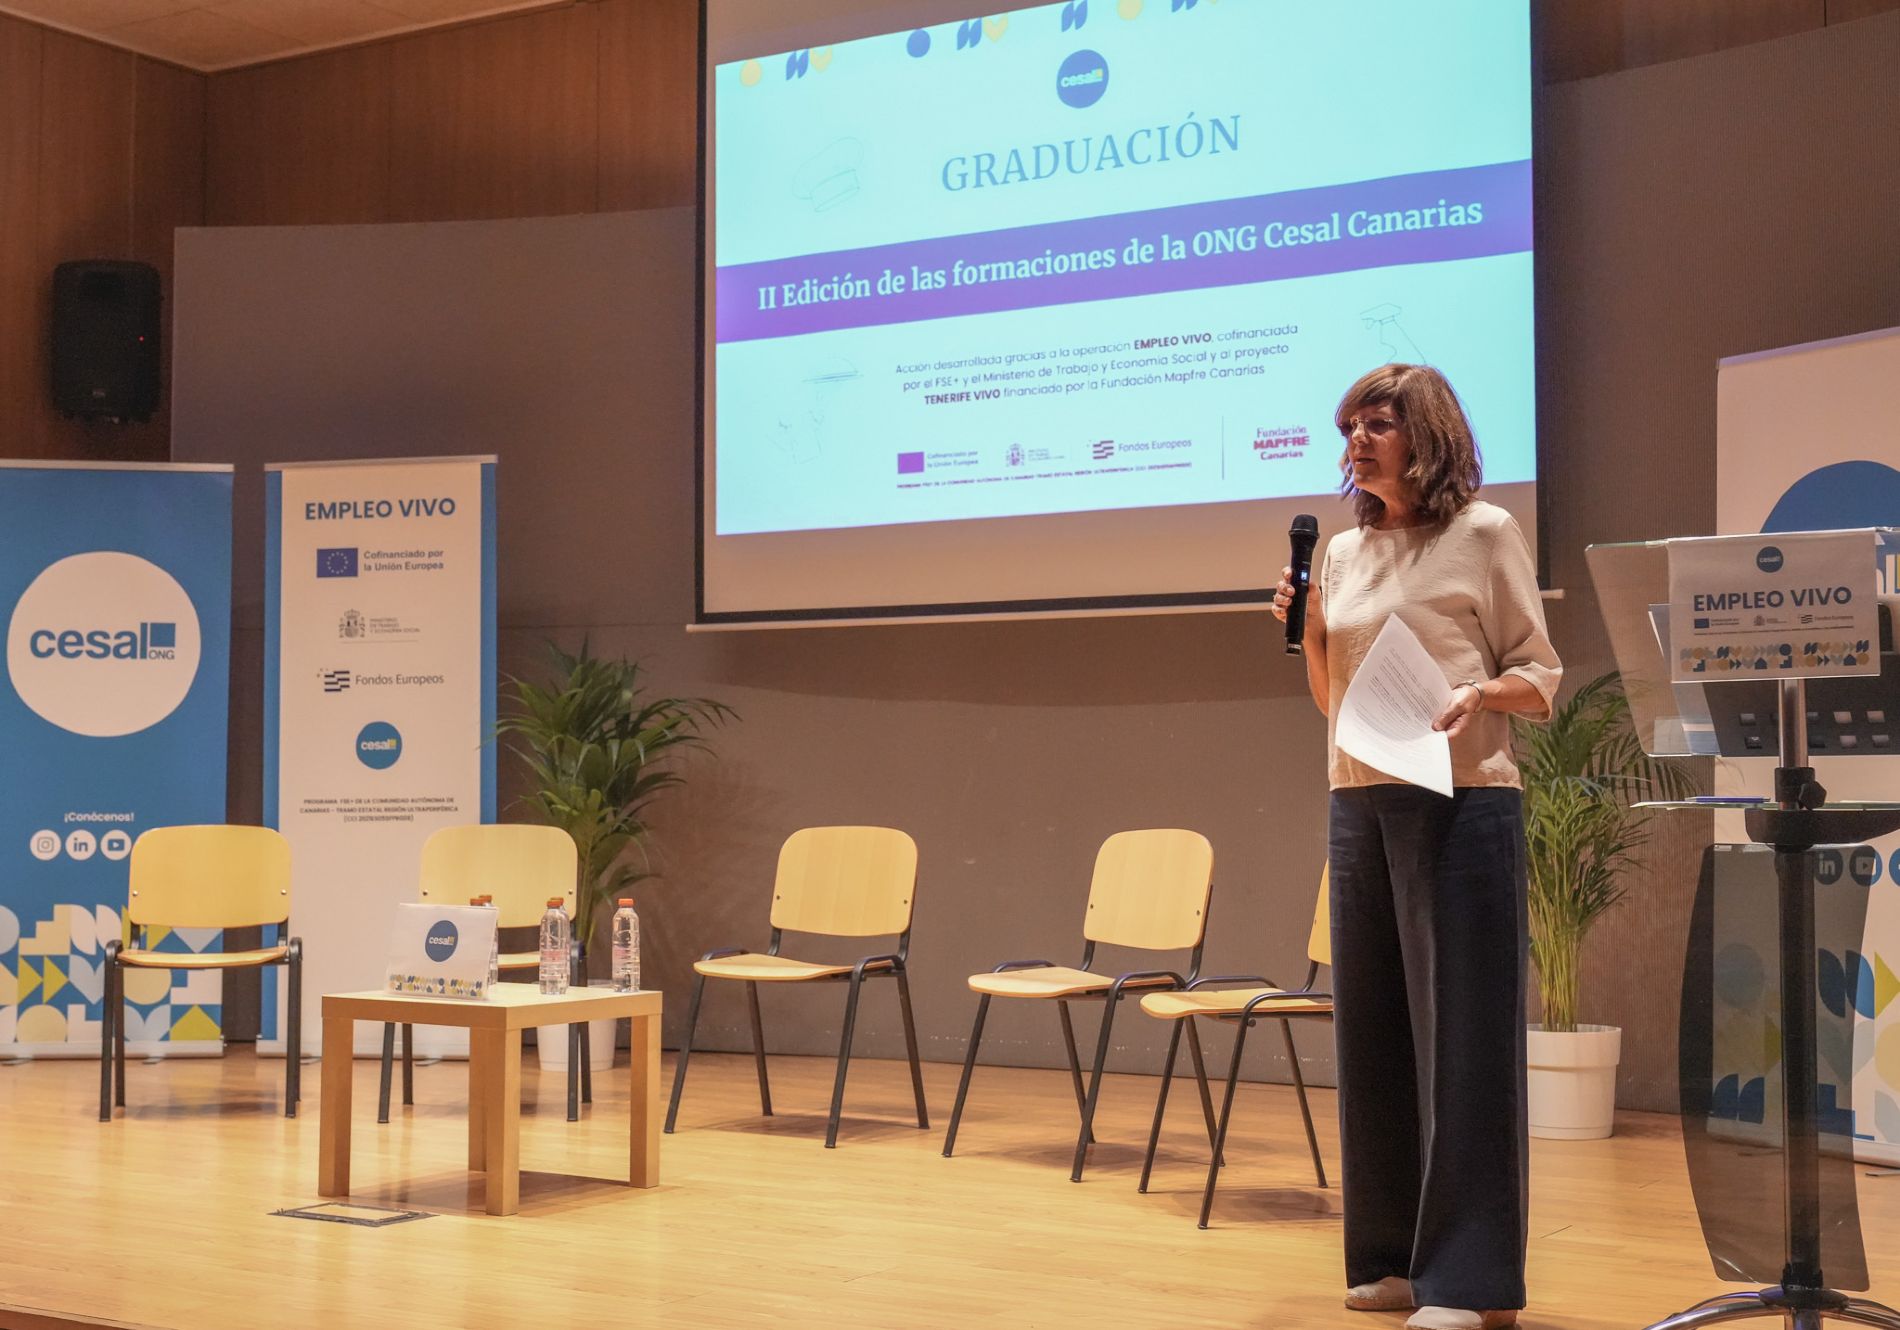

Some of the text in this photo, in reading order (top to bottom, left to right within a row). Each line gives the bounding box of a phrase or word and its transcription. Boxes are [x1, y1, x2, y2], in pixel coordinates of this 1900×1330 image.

[942, 112, 1240, 191] GRADUACIÓN
[758, 199, 1483, 310] II Edición de las formaciones de la ONG Cesal Canarias
[896, 362, 930, 374] Acción
[934, 355, 1002, 371] desarrollada
[1005, 351, 1046, 366] gracias
[1049, 349, 1057, 358] a
[1060, 346, 1070, 357] la
[1072, 342, 1130, 359] operación
[1134, 335, 1179, 350] EMPLEO
[1217, 324, 1298, 341] cofinanciada
[903, 380, 920, 392] por
[924, 378, 933, 388] el
[962, 377, 969, 387] y
[971, 373, 981, 384] el
[983, 368, 1035, 383] Ministerio
[1038, 366, 1052, 377] de
[1056, 362, 1098, 376] Trabajo
[1101, 364, 1107, 373] y
[1172, 351, 1207, 364] Social
[1210, 352, 1217, 363] y
[1220, 348, 1231, 359] al
[1234, 344, 1289, 361] proyecto
[924, 363, 1265, 405] TENERIFE VIVO financiado por la Fundación Mapfre Canarias
[1257, 425, 1307, 438] Fundación
[1118, 438, 1192, 453] Fondos Europeos
[1253, 435, 1309, 450] MAPFRE
[1260, 449, 1303, 460] Canarias
[305, 498, 456, 520] EMPLEO VIVO
[364, 550, 443, 560] Cofinanciado por
[364, 560, 444, 571] la Unión Europea
[1694, 586, 1852, 612] EMPLEO VIVO
[30, 622, 147, 660] cesal
[149, 649, 175, 660] ONG
[356, 673, 444, 686] Fondos Europeos
[361, 739, 393, 750] cesal
[64, 812, 135, 823] ¡Conócenos!
